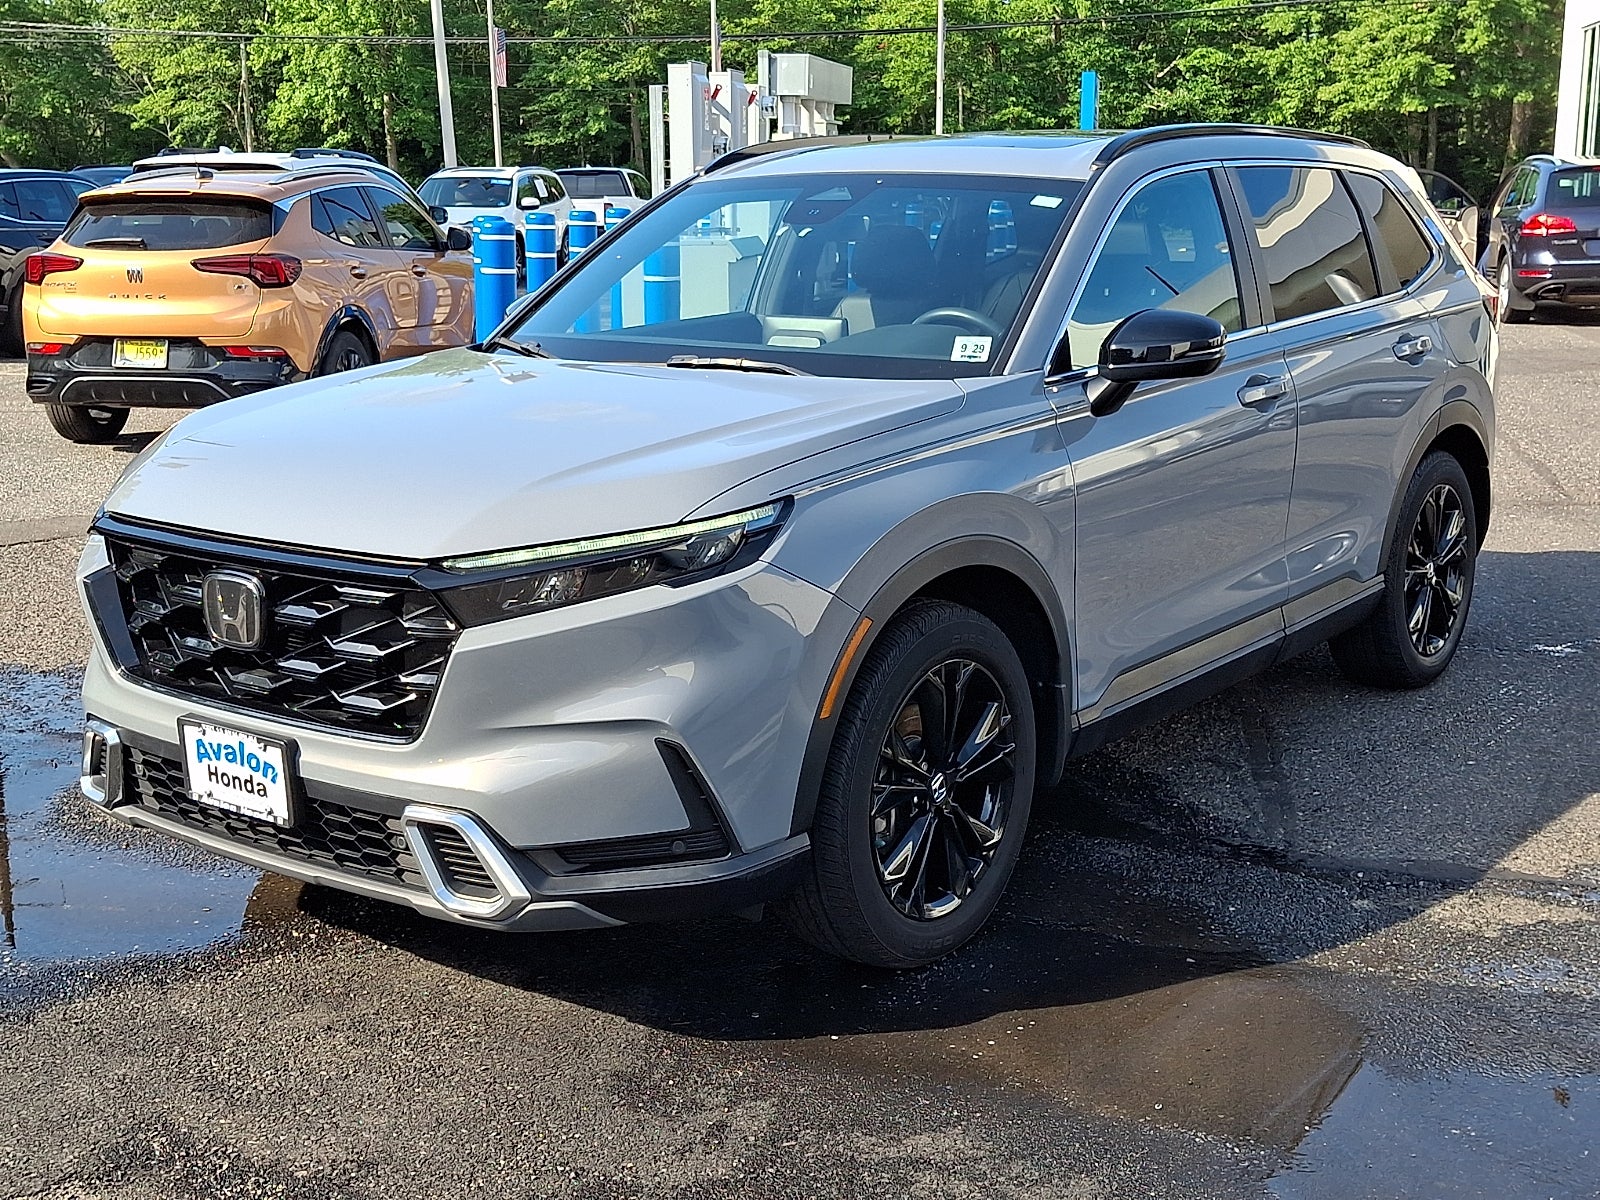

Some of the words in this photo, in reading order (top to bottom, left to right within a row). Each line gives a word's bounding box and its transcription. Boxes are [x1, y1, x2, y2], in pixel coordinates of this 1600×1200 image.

[960, 343, 967, 353] 9
[971, 344, 985, 354] 29
[195, 738, 279, 785] Avalon
[207, 763, 268, 798] Honda
